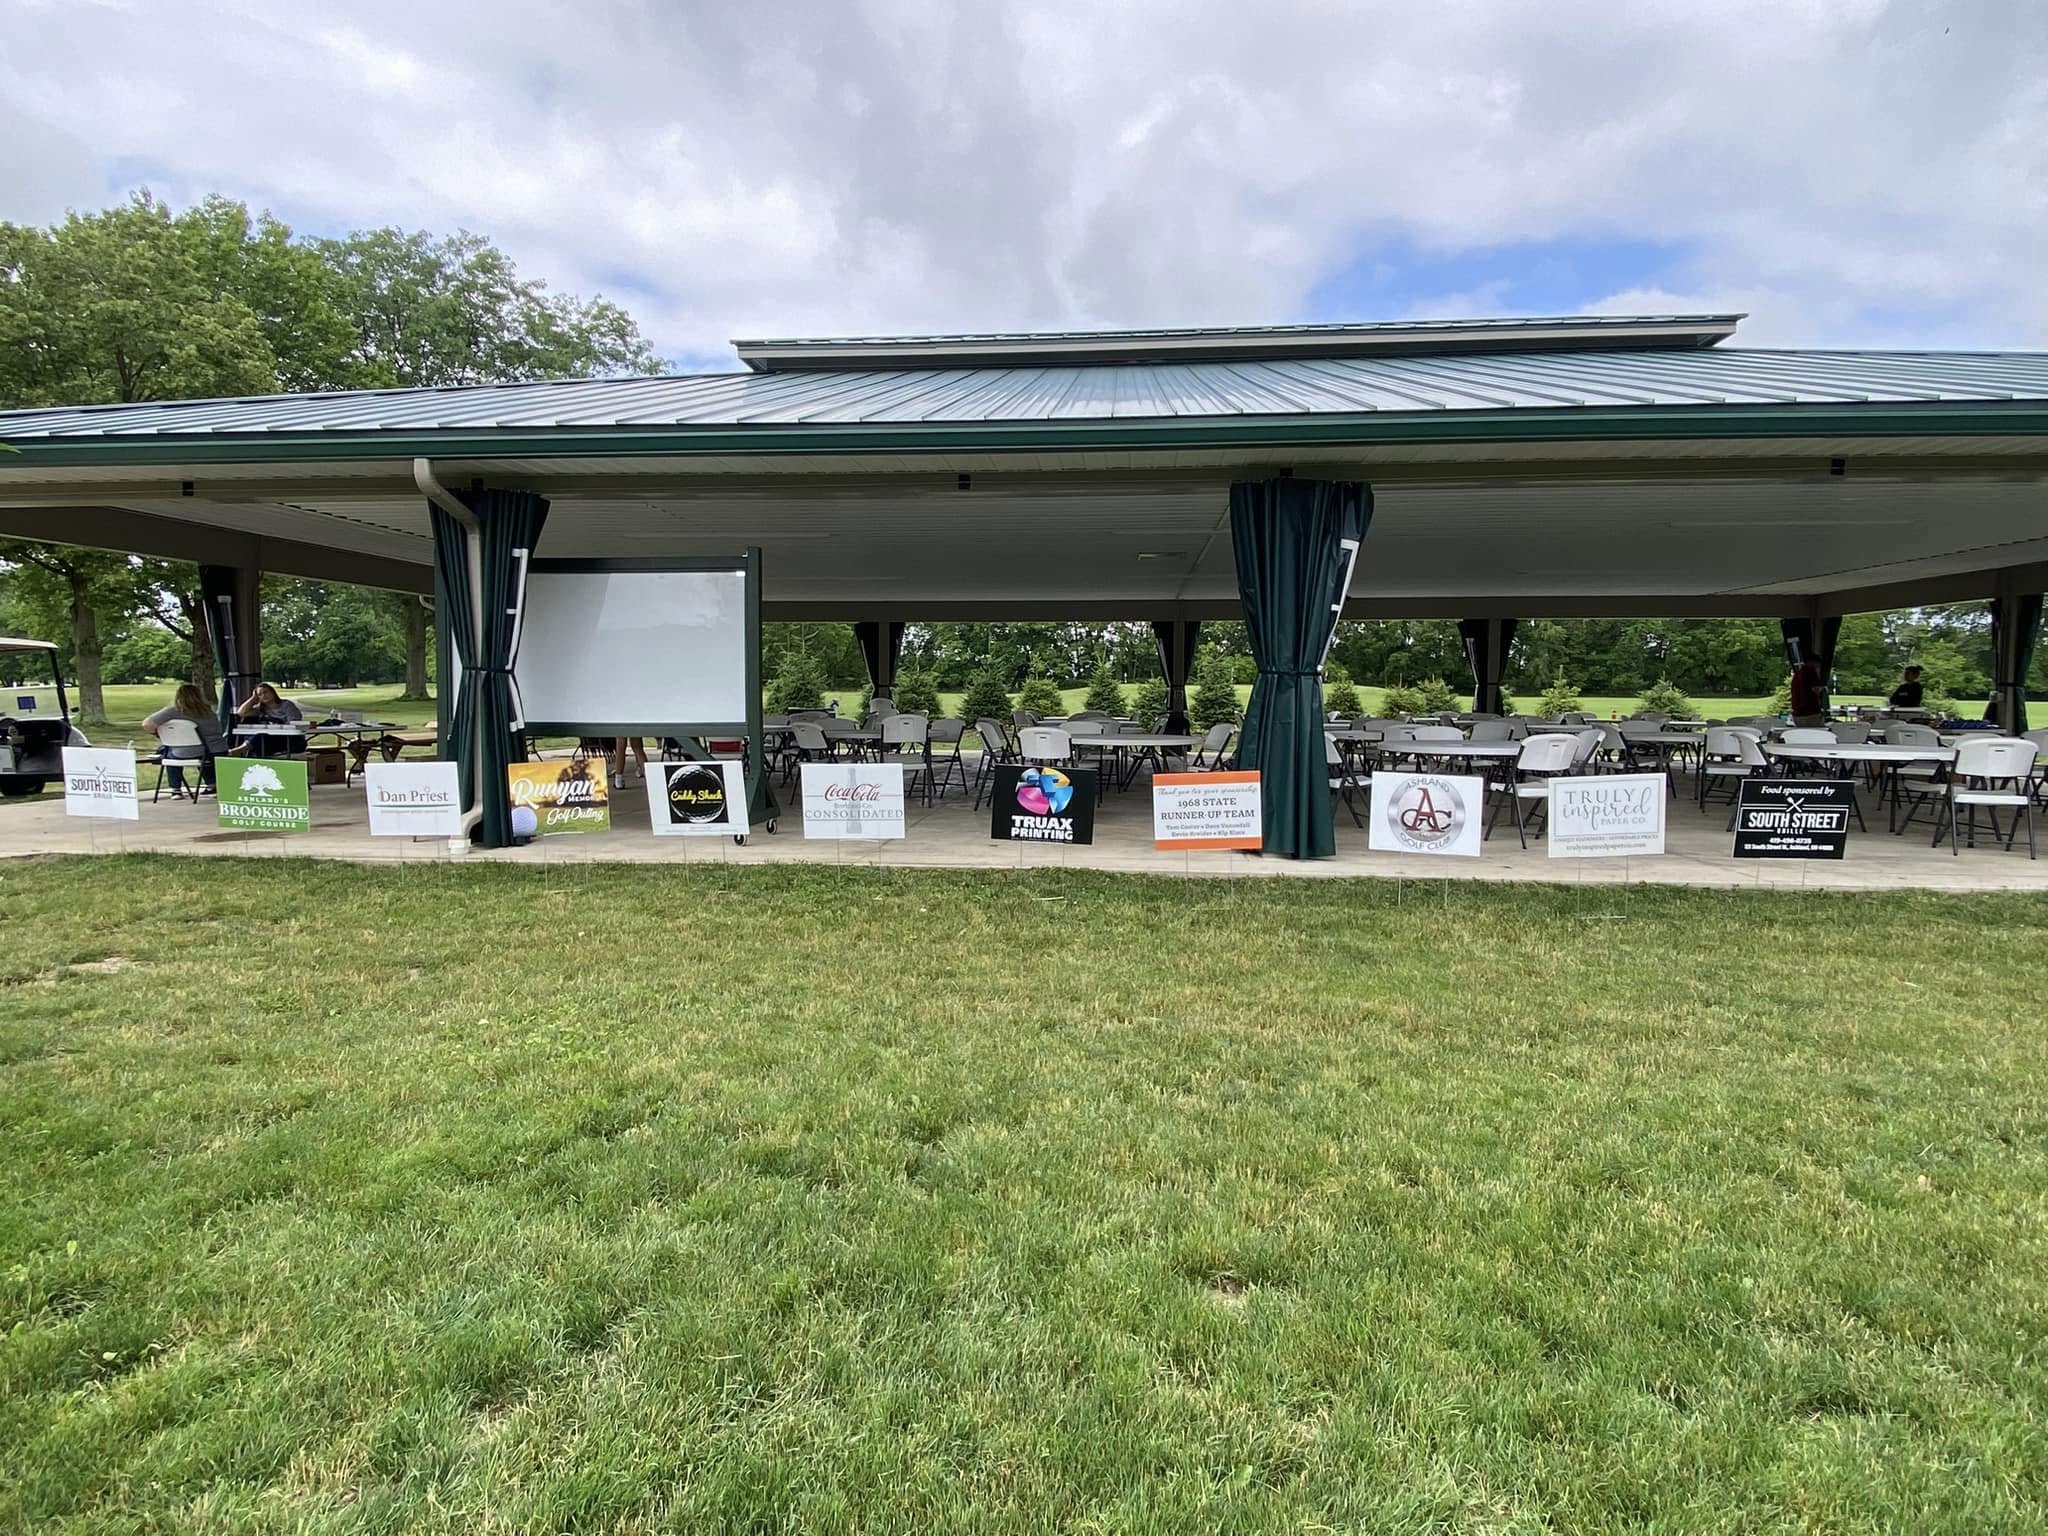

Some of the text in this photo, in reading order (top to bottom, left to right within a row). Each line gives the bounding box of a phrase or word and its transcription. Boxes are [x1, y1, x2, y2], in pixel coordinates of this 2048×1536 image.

[71, 778, 132, 794] SOUTH STREET
[1406, 777, 1450, 793] ASHLAND
[1760, 785, 1836, 797] Food sponsored by
[238, 796, 289, 804] ASHLAND'S
[378, 787, 449, 803] Dan Priest
[511, 777, 596, 810] Runyan
[670, 789, 724, 804] Caddy Shack
[1565, 787, 1635, 805] TRULY
[1178, 797, 1237, 809] 1968 STATE
[1563, 786, 1652, 831] inspired
[219, 803, 309, 820] BROOKSIDE
[546, 806, 604, 825] Golf Outing
[804, 809, 903, 819] CONSOLIDATED
[1161, 809, 1255, 820] RUNNER-UP TEAM
[260, 820, 297, 828] COURSE
[1011, 815, 1074, 830] TRUAX
[1748, 812, 1841, 829] SOUTH STREET
[1010, 827, 1073, 840] PRINTING
[1399, 831, 1451, 850] GOLF CLUB
